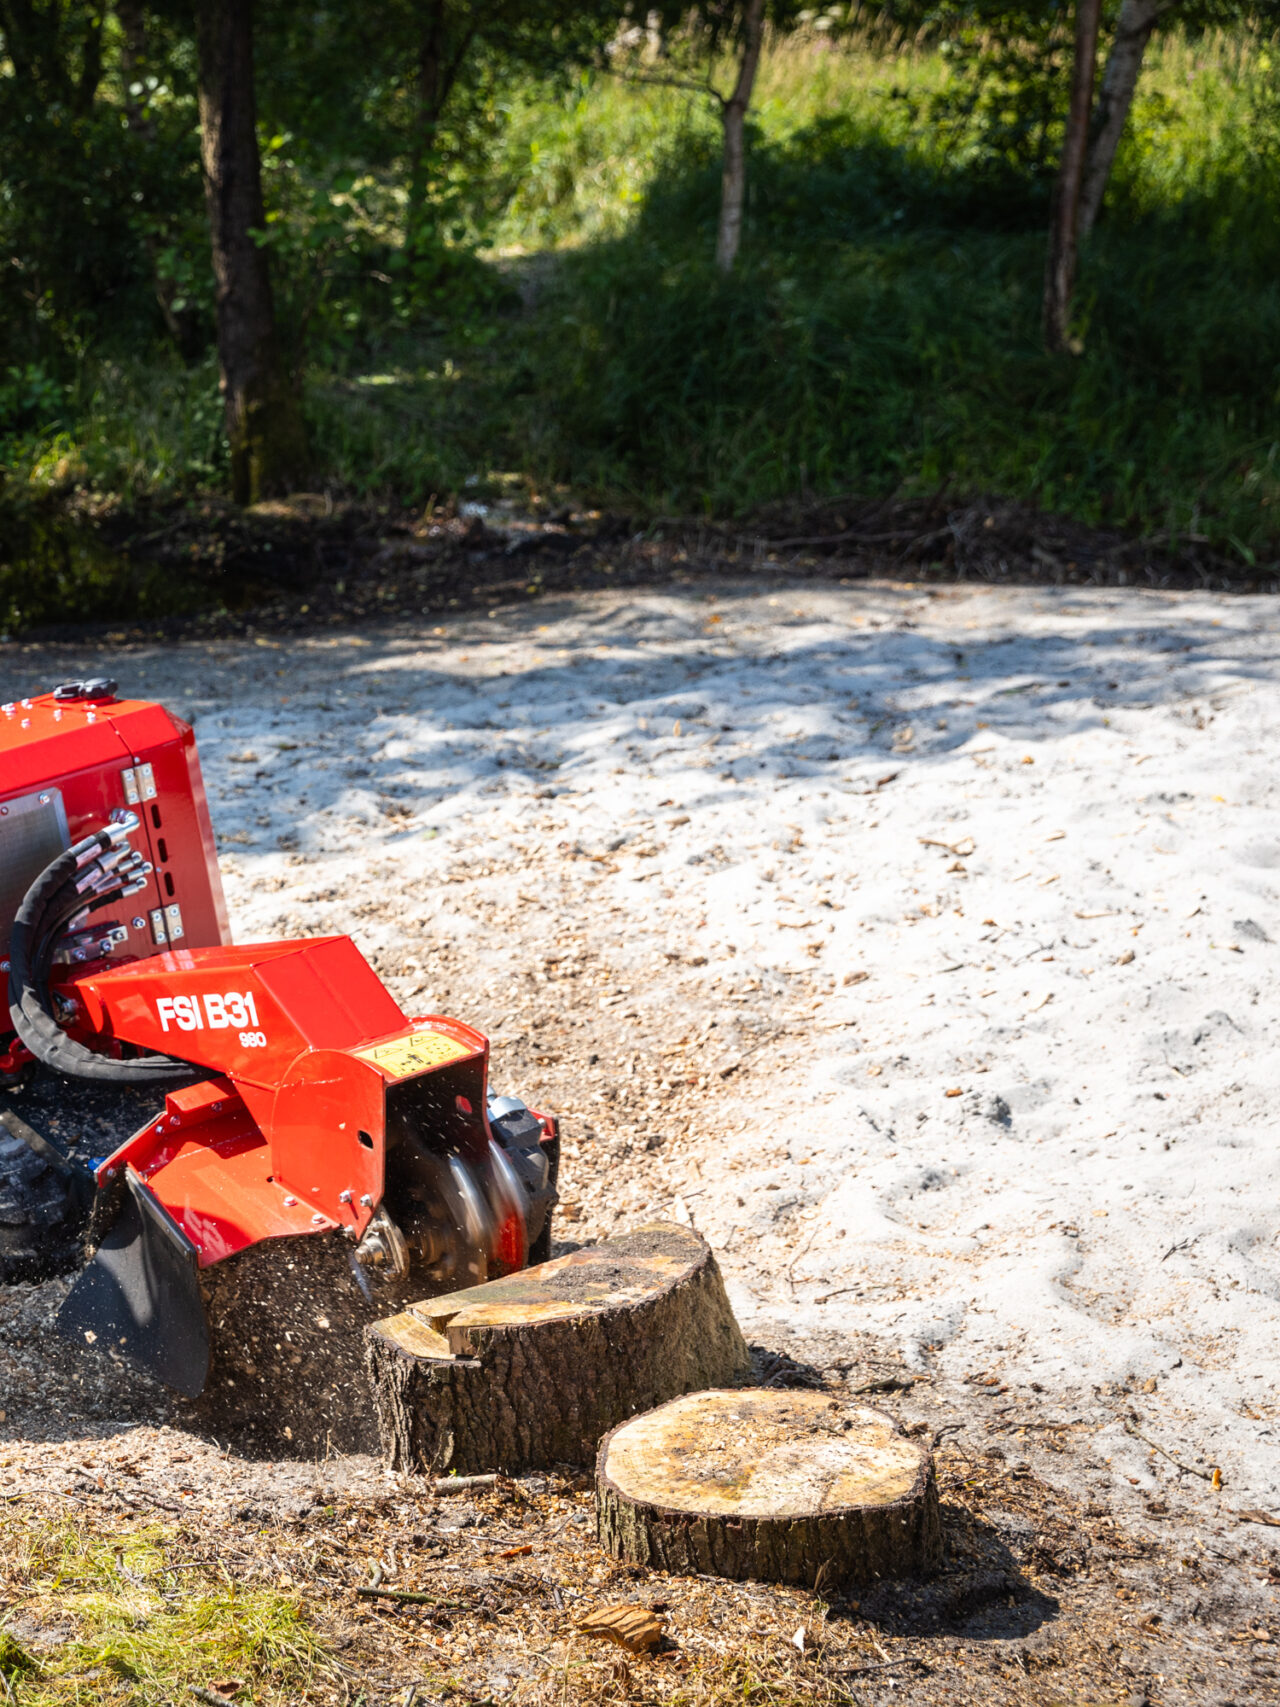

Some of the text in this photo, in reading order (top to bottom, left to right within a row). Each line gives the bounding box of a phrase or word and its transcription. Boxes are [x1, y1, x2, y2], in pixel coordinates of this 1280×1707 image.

[156, 991, 260, 1032] FSI B31
[238, 1031, 267, 1048] 980
